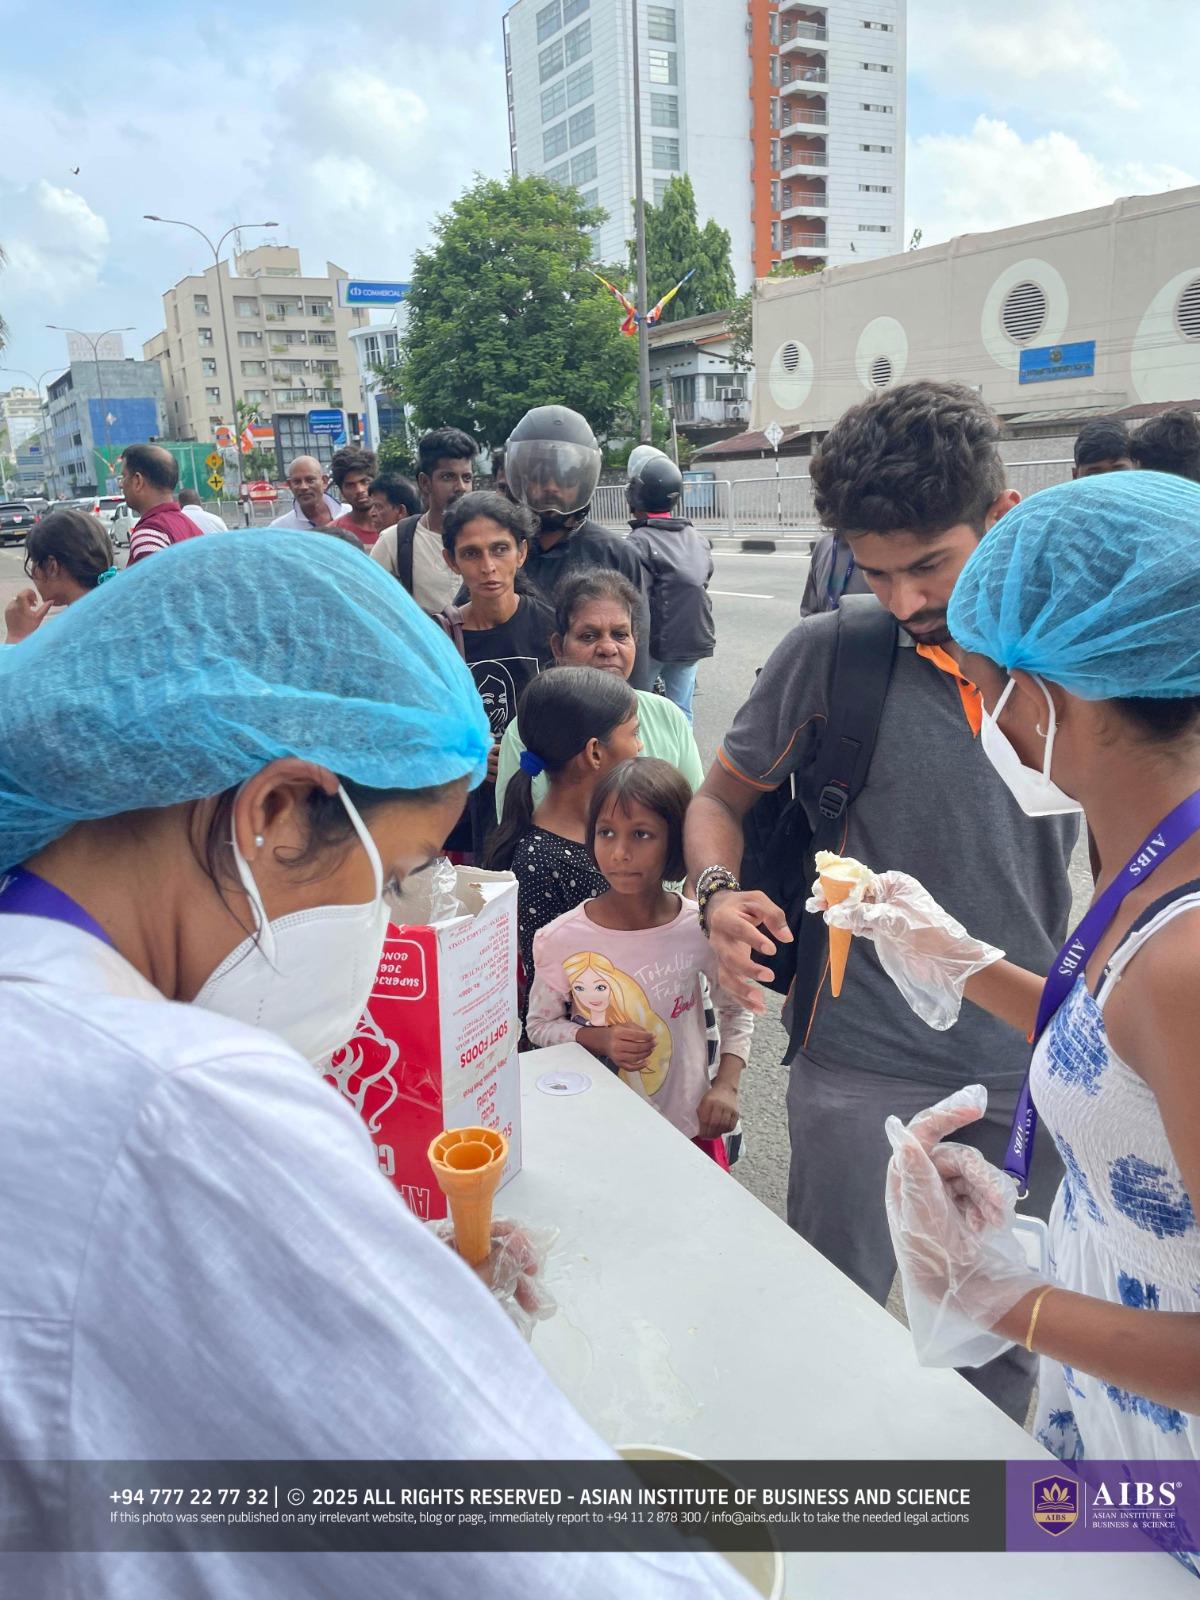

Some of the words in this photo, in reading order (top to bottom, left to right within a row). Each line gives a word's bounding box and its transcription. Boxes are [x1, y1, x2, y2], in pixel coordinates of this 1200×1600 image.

[1130, 833, 1165, 876] AIBS
[380, 964, 402, 973] ICE
[1058, 938, 1085, 977] AIBS
[490, 1020, 508, 1042] SOFT
[460, 1039, 489, 1068] FOODS
